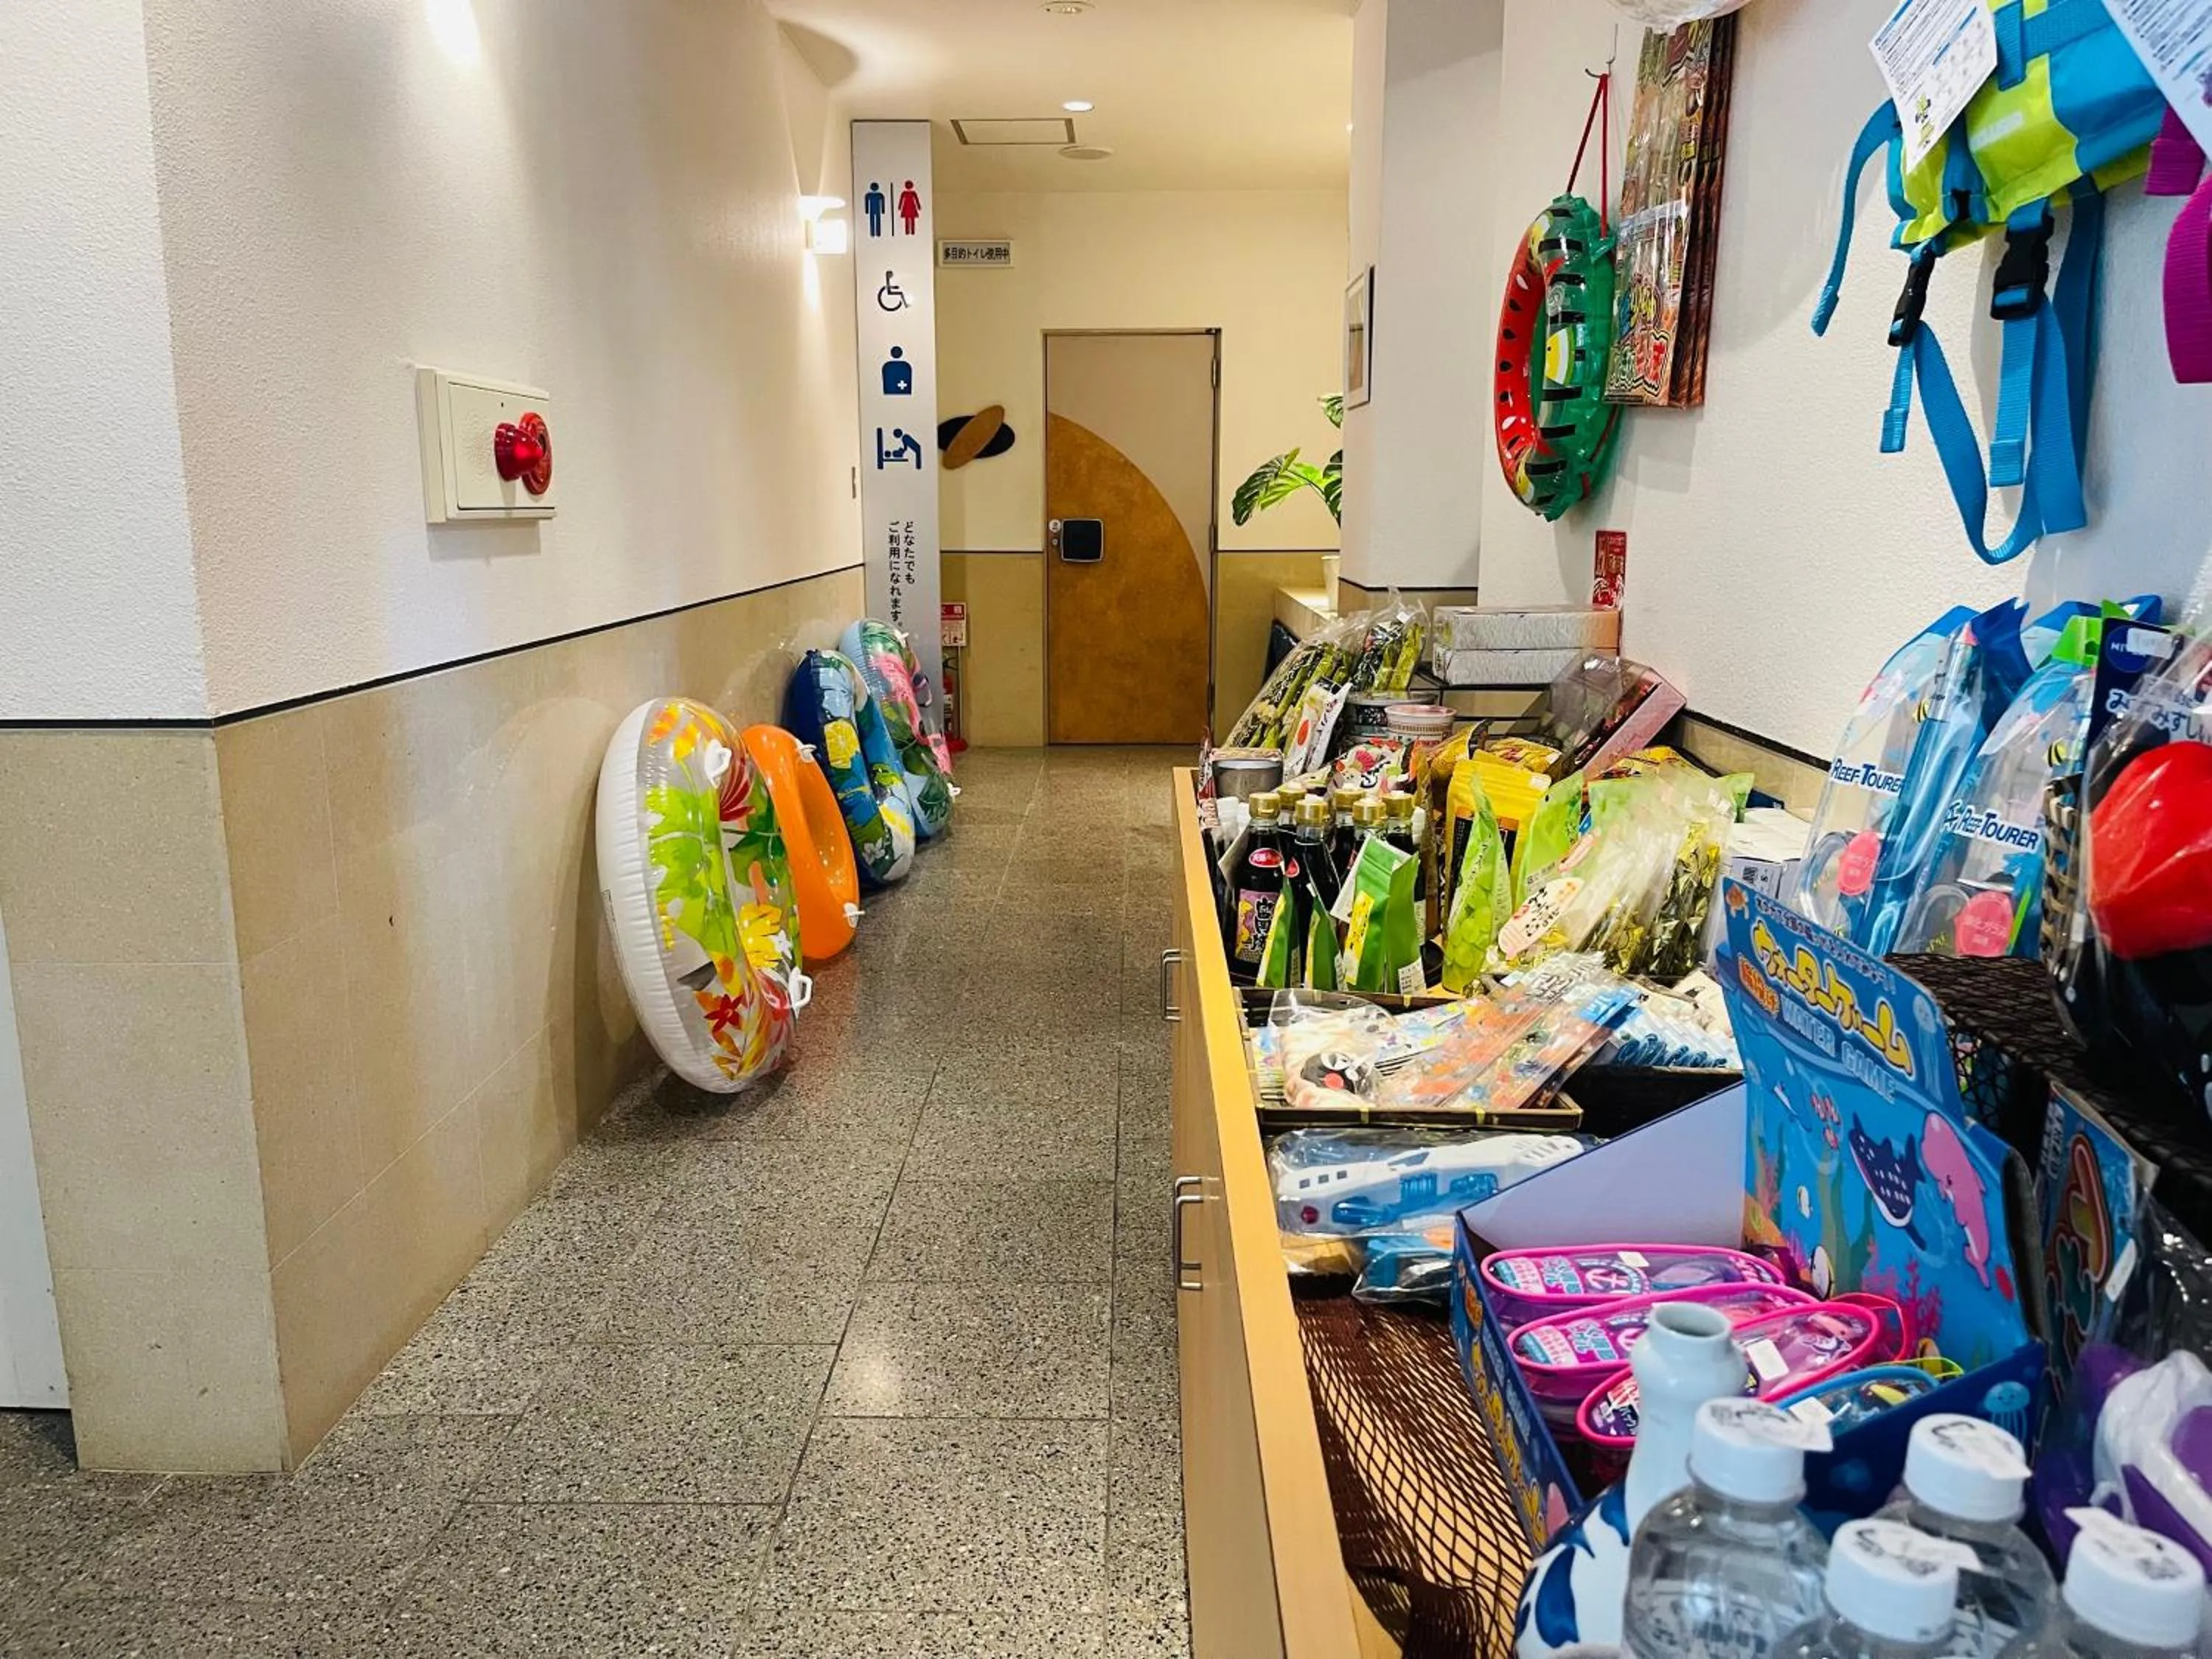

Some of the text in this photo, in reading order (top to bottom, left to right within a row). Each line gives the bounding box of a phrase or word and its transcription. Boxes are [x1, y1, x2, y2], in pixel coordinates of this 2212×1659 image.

[944, 247, 1009, 260] 多目的トイレ使用中
[888, 521, 902, 627] ご利用になれます。
[904, 521, 915, 584] どなたでも
[1780, 995, 1836, 1057] WATER
